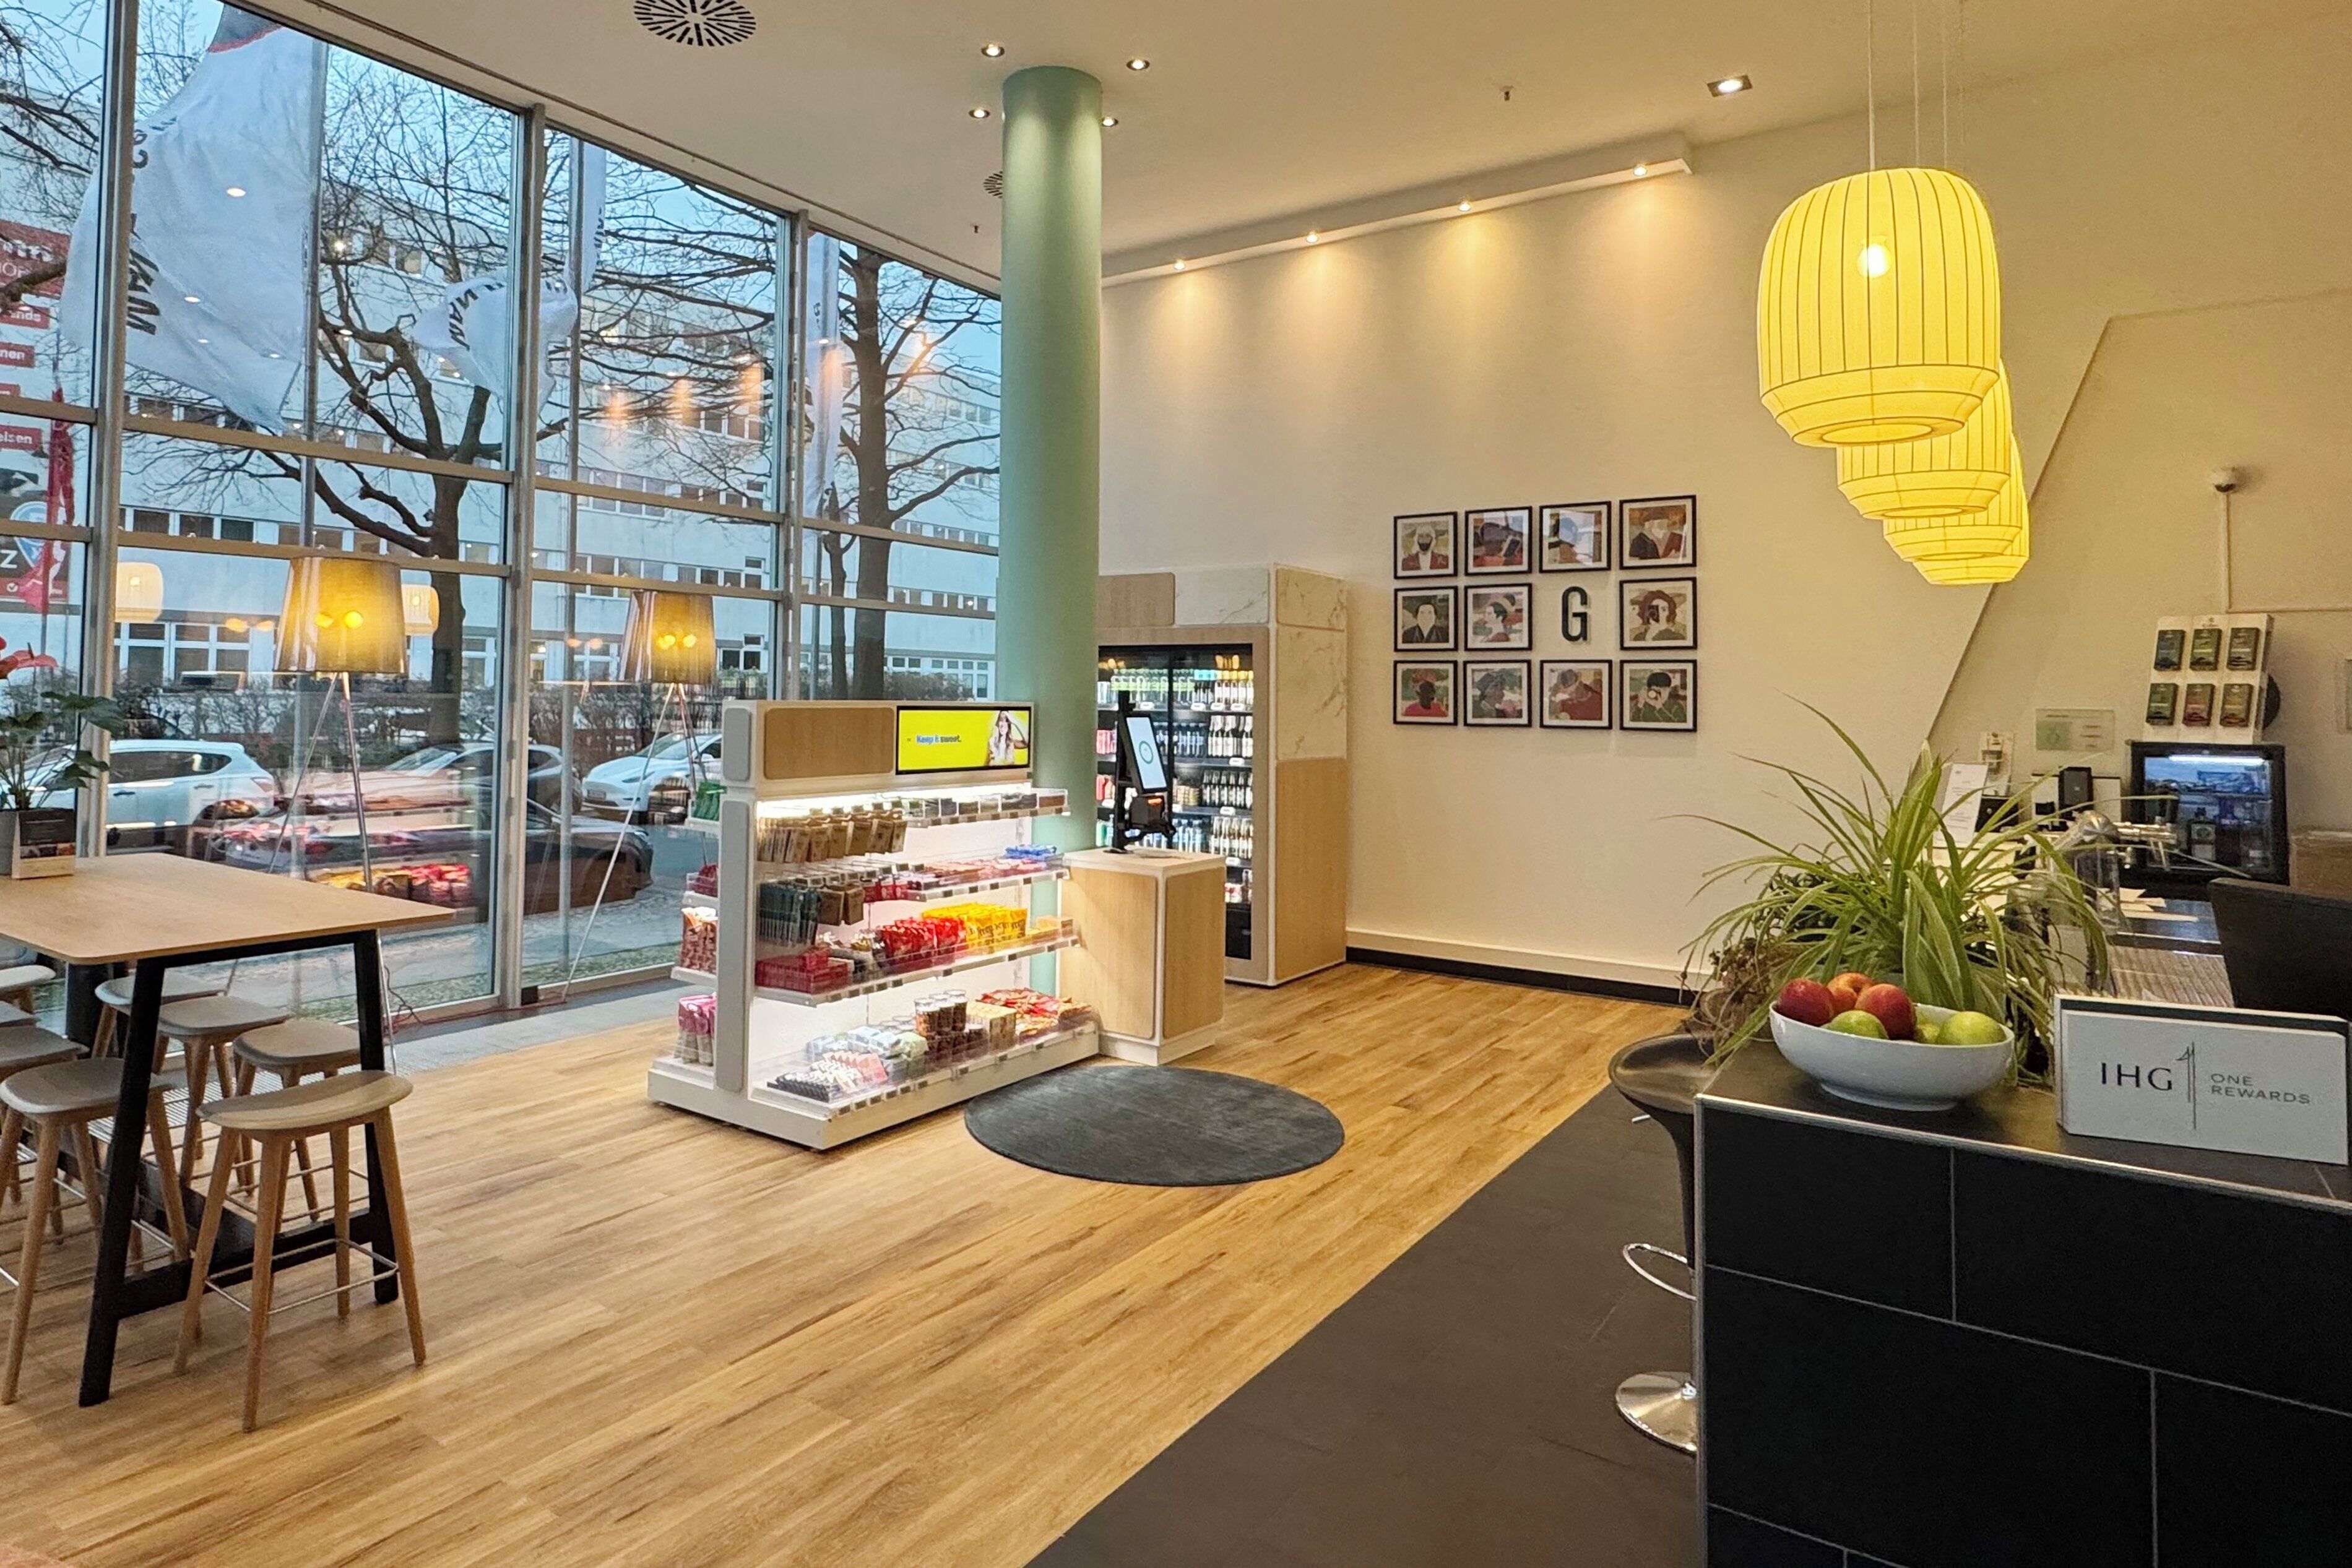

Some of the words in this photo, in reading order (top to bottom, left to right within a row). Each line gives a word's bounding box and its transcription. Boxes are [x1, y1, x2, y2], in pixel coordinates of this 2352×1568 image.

[1562, 586, 1588, 642] G
[2101, 1062, 2173, 1091] IHG
[2211, 1073, 2254, 1087] ONE
[2211, 1085, 2311, 1105] REWARDS
